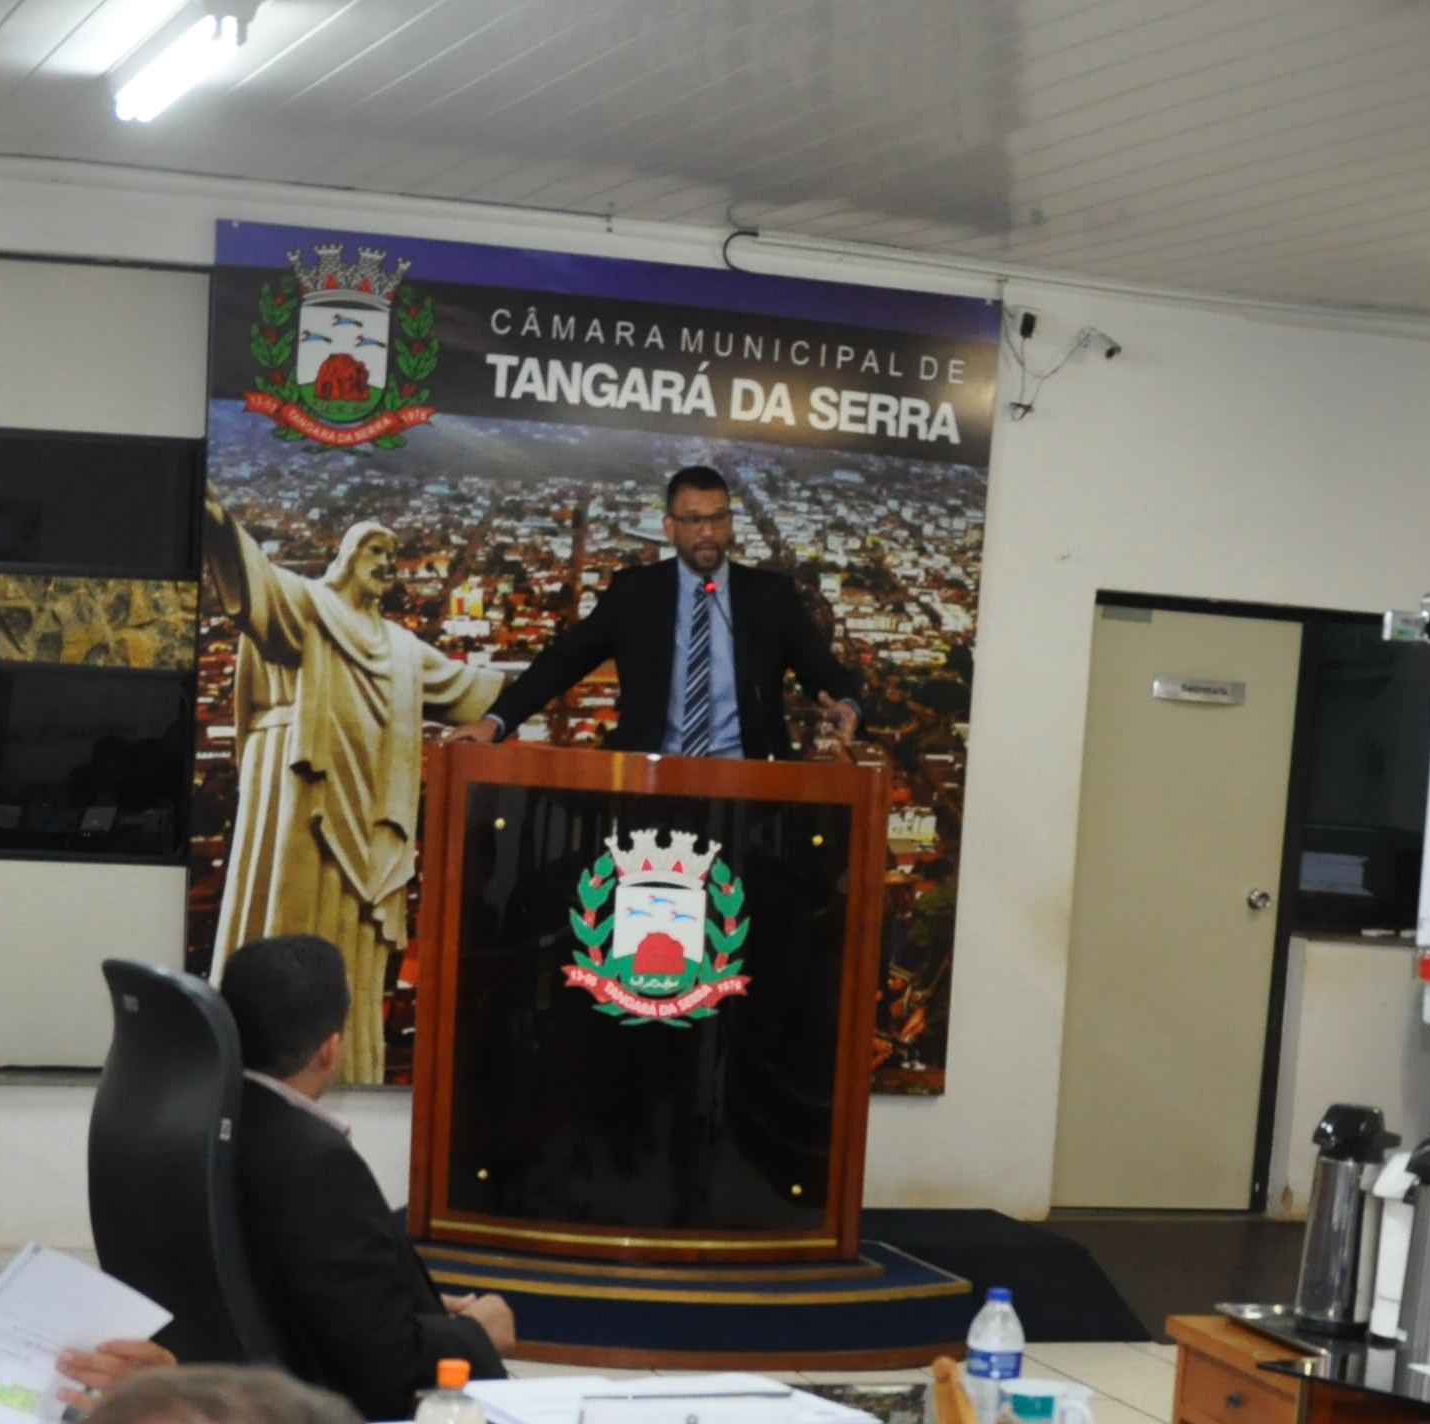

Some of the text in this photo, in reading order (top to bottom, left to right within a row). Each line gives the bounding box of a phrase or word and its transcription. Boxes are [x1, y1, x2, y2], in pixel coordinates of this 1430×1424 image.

[490, 306, 966, 384] CÂMARA MUNICIPAL DE
[486, 354, 961, 444] TANGARÁ DA SERRA
